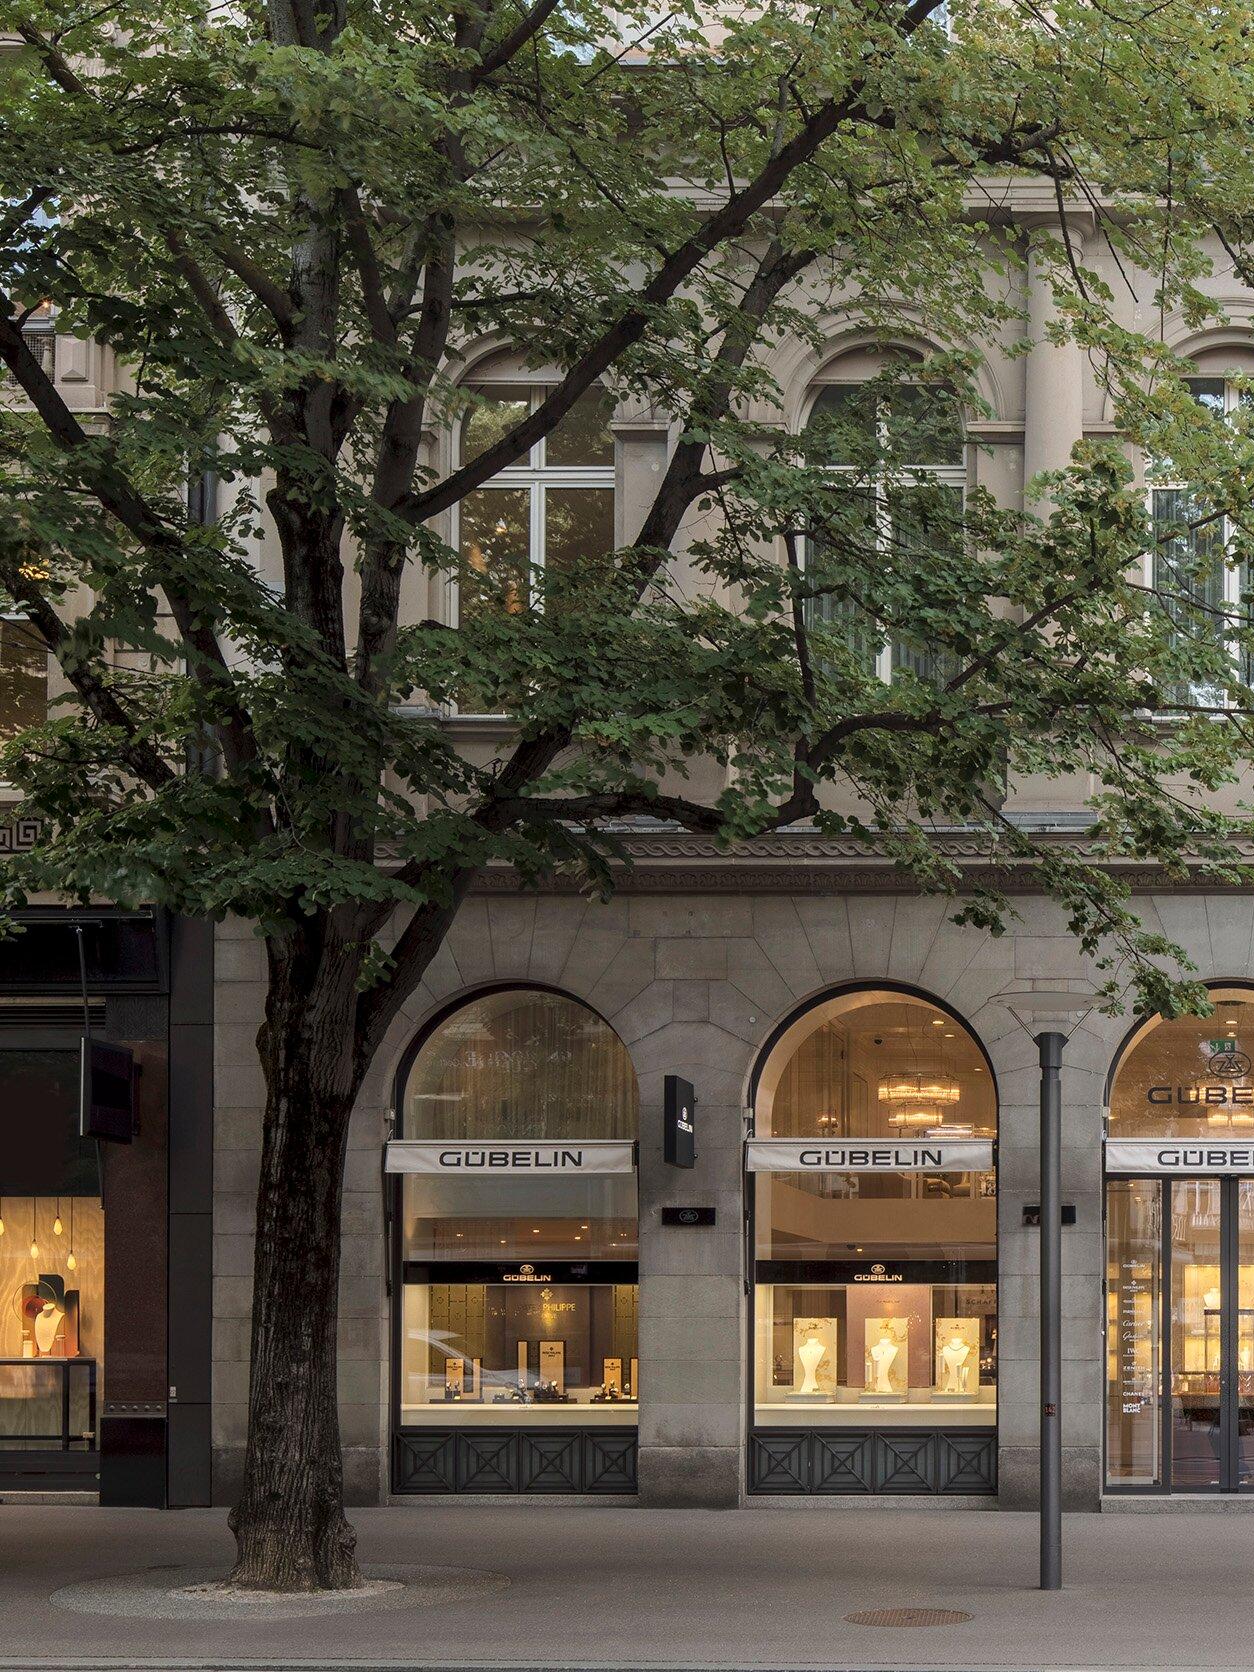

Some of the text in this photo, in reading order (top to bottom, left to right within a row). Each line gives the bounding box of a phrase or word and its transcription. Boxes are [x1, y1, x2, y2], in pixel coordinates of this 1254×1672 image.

[439, 1150, 583, 1168] GÜBELIN
[799, 1150, 942, 1166] GÜBELIN
[503, 1274, 551, 1282] GÜBELIN
[853, 1274, 903, 1282] GÜBELIN
